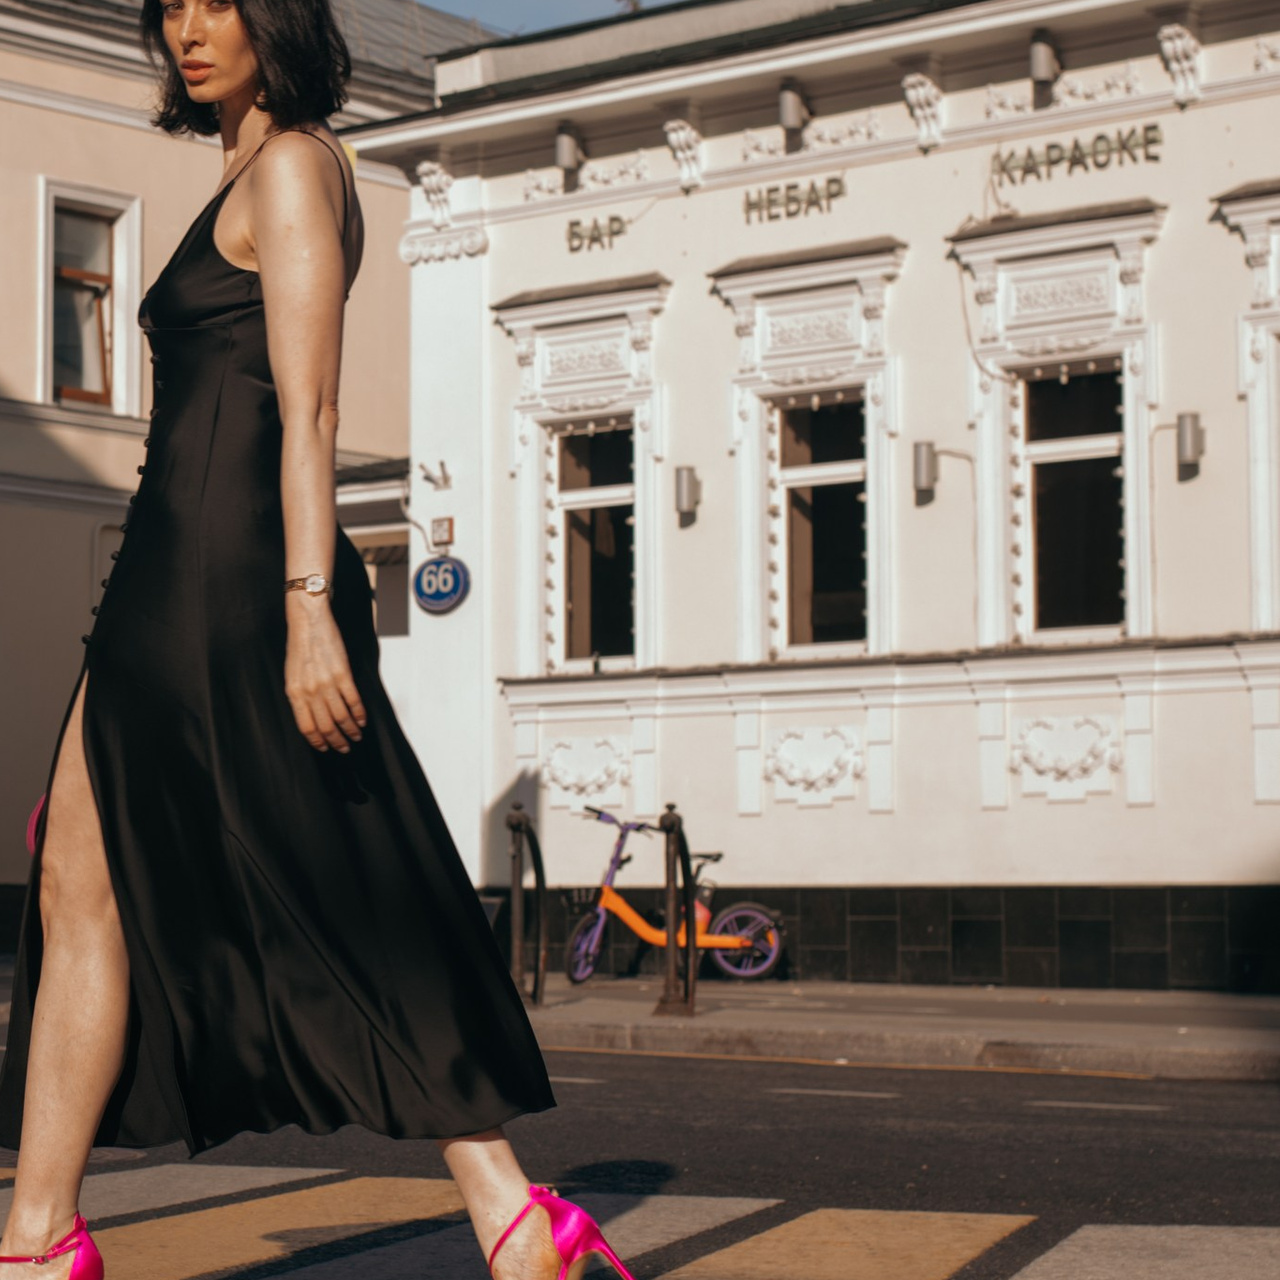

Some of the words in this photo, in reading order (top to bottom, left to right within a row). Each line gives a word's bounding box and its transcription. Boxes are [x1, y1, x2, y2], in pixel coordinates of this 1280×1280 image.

[995, 123, 1161, 188] КАРАОКЕ
[743, 177, 845, 224] НЕБАР
[567, 215, 626, 253] БАР
[422, 563, 454, 595] 66
